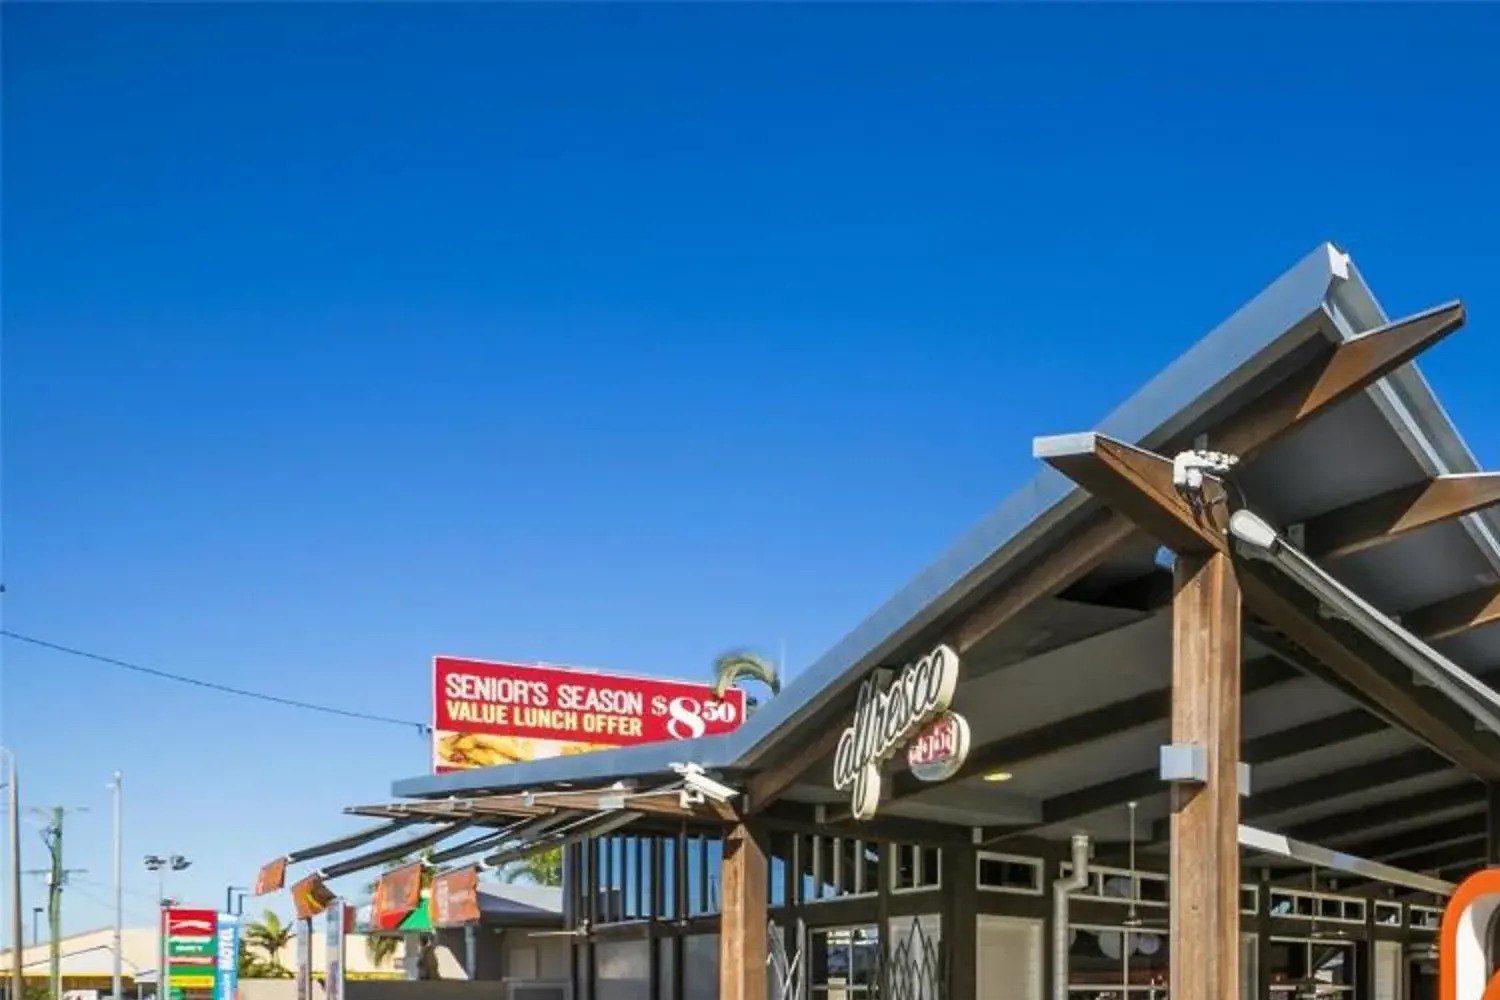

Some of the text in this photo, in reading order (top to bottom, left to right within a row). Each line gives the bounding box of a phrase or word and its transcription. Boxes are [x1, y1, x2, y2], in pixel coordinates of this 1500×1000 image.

[445, 672, 643, 717] SENIOR'S SEASON
[446, 699, 643, 737] VALUE LUNCH OFFER
[834, 644, 958, 819] alfresco
